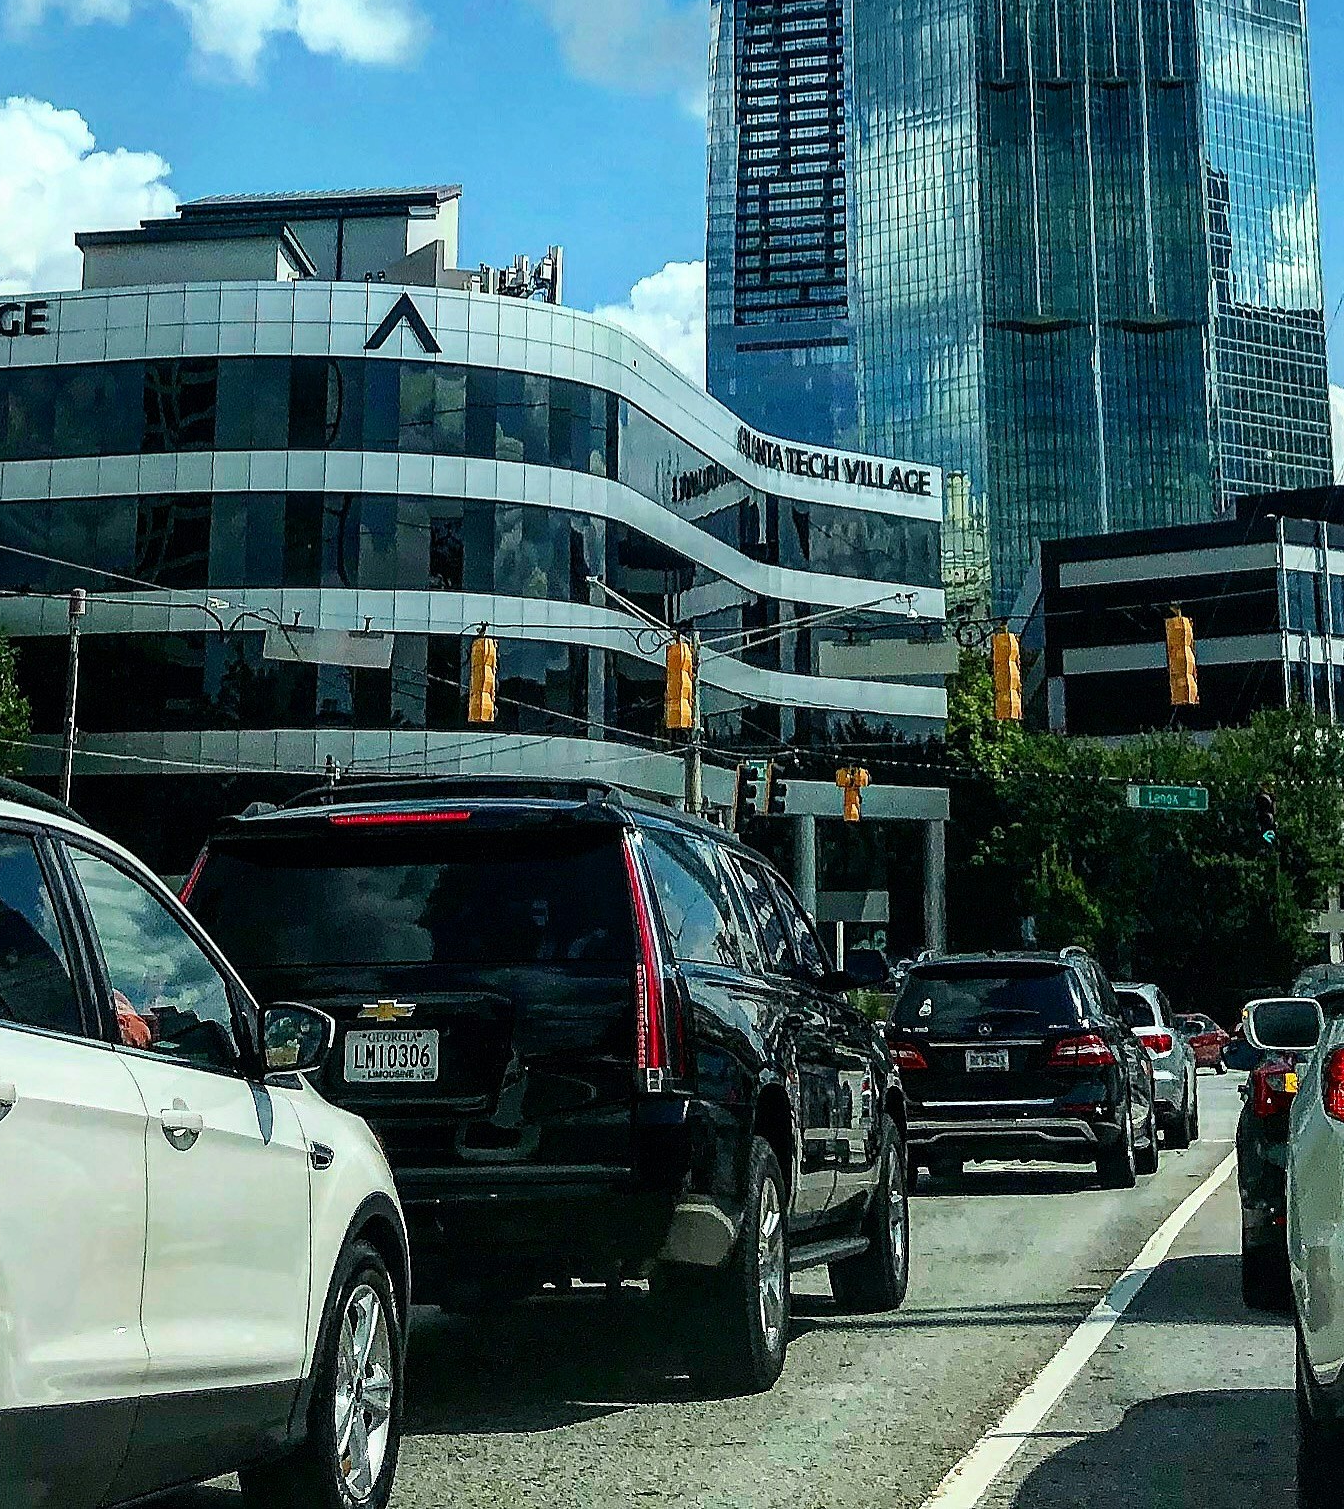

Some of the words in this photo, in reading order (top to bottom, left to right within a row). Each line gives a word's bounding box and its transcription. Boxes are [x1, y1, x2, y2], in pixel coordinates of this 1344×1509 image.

[785, 446, 840, 481] TECH
[842, 457, 932, 496] VILLAGE
[367, 1032, 417, 1043] GEORGIA
[354, 1043, 430, 1069] LM10306
[367, 1069, 415, 1080] LIMOUSINE
